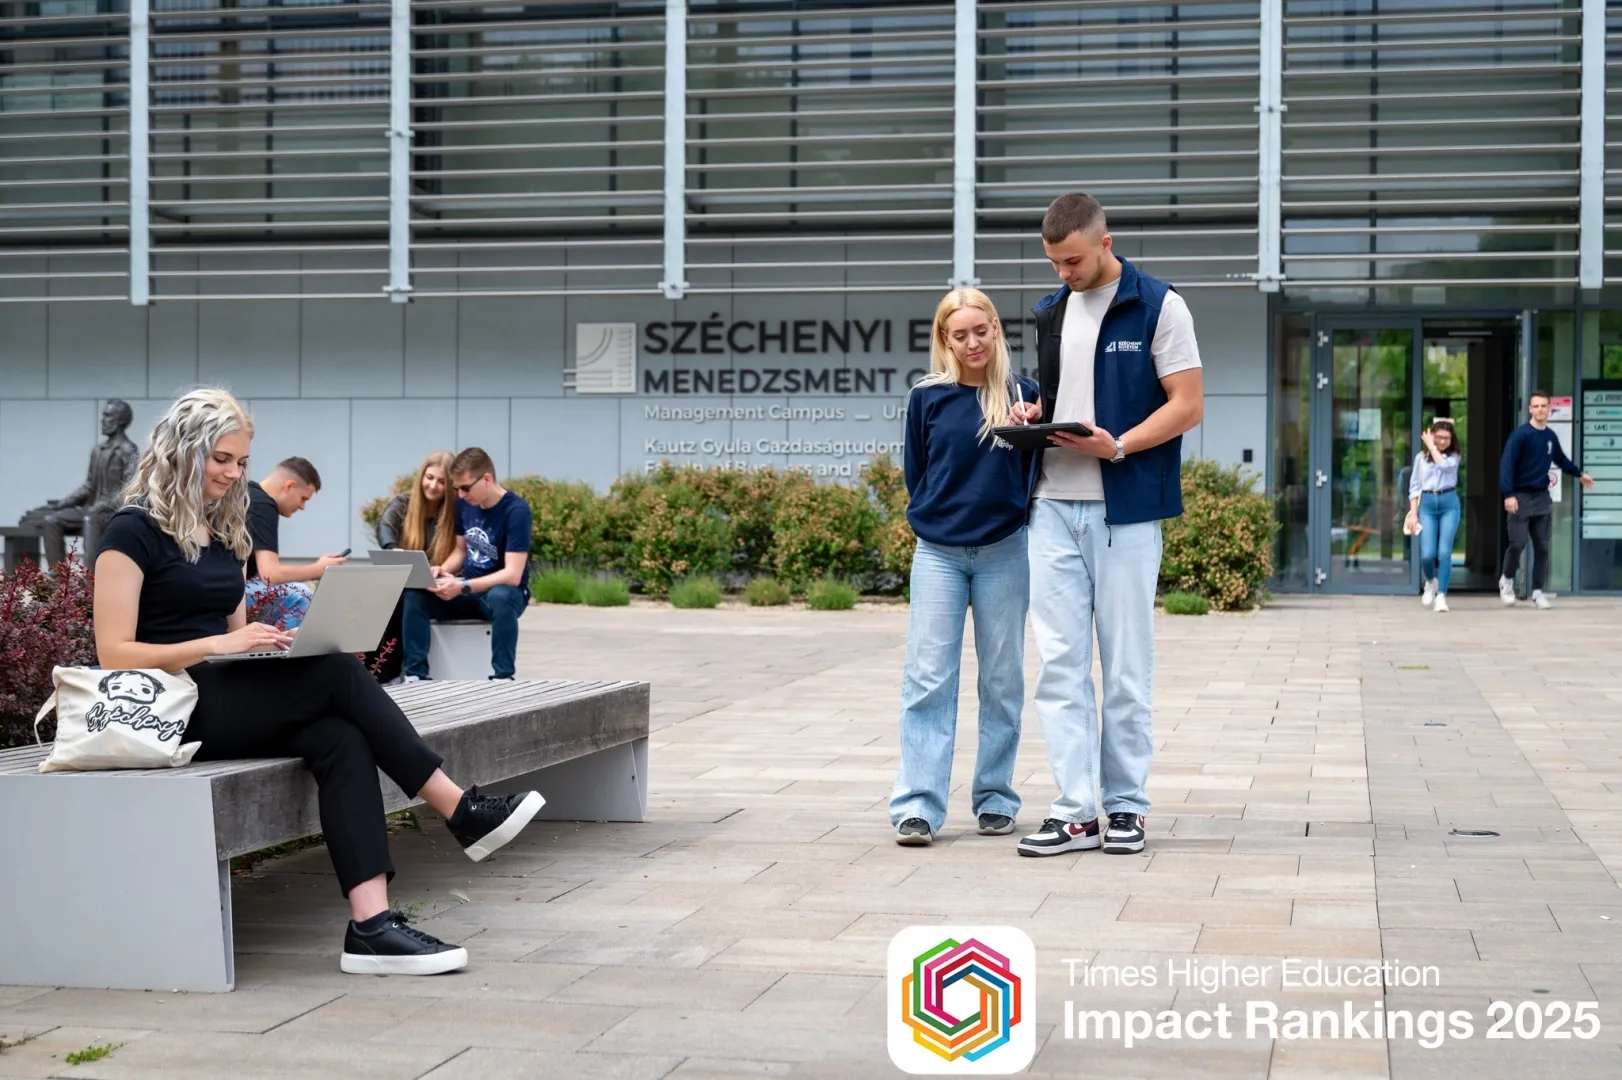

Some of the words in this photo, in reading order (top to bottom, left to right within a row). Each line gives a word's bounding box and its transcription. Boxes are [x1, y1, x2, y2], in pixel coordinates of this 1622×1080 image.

[643, 312, 891, 354] SZÉCHENYI
[644, 368, 897, 393] MENEDZSMENT
[644, 404, 764, 424] Management
[768, 404, 845, 424] Campus
[644, 438, 697, 453] Kautz
[700, 438, 752, 457] Gyula
[818, 460, 852, 478] and
